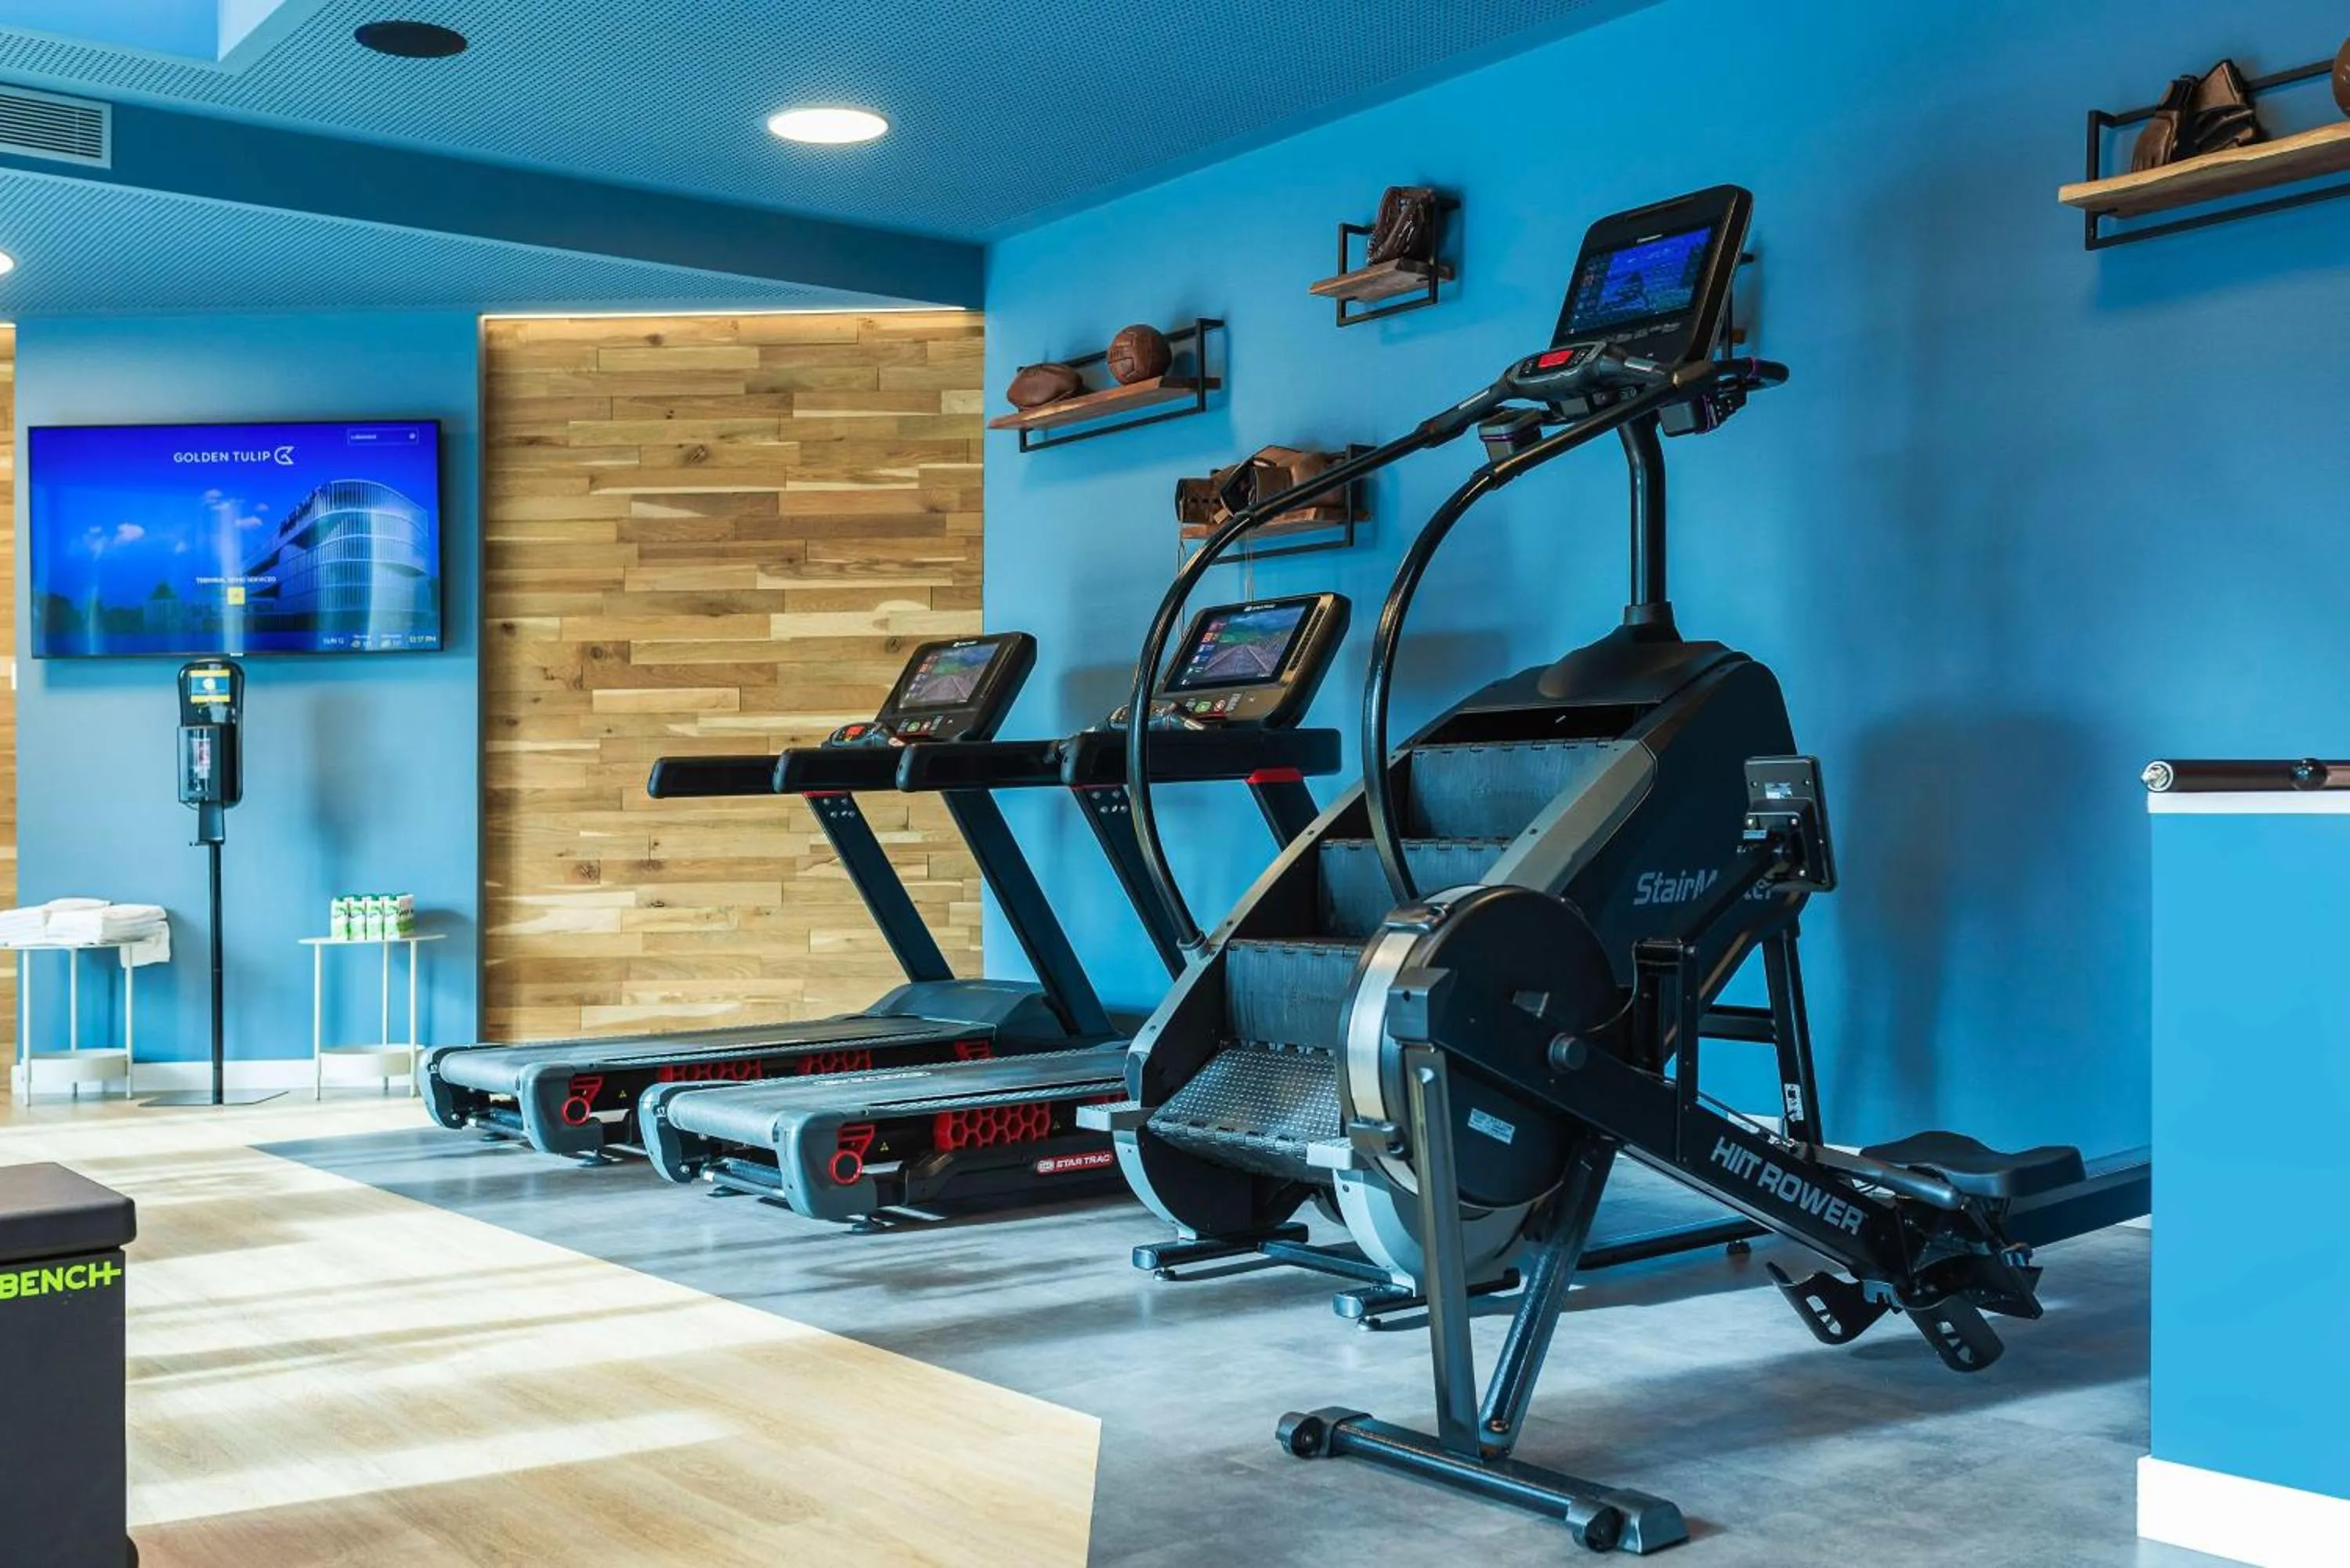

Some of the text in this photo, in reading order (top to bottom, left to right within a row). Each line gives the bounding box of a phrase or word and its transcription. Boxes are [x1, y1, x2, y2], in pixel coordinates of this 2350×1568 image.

[173, 450, 271, 463] GOLDEN TULIP
[1056, 1154, 1110, 1169] STAR TRAC
[1710, 1136, 1864, 1236] HIIT ROWER
